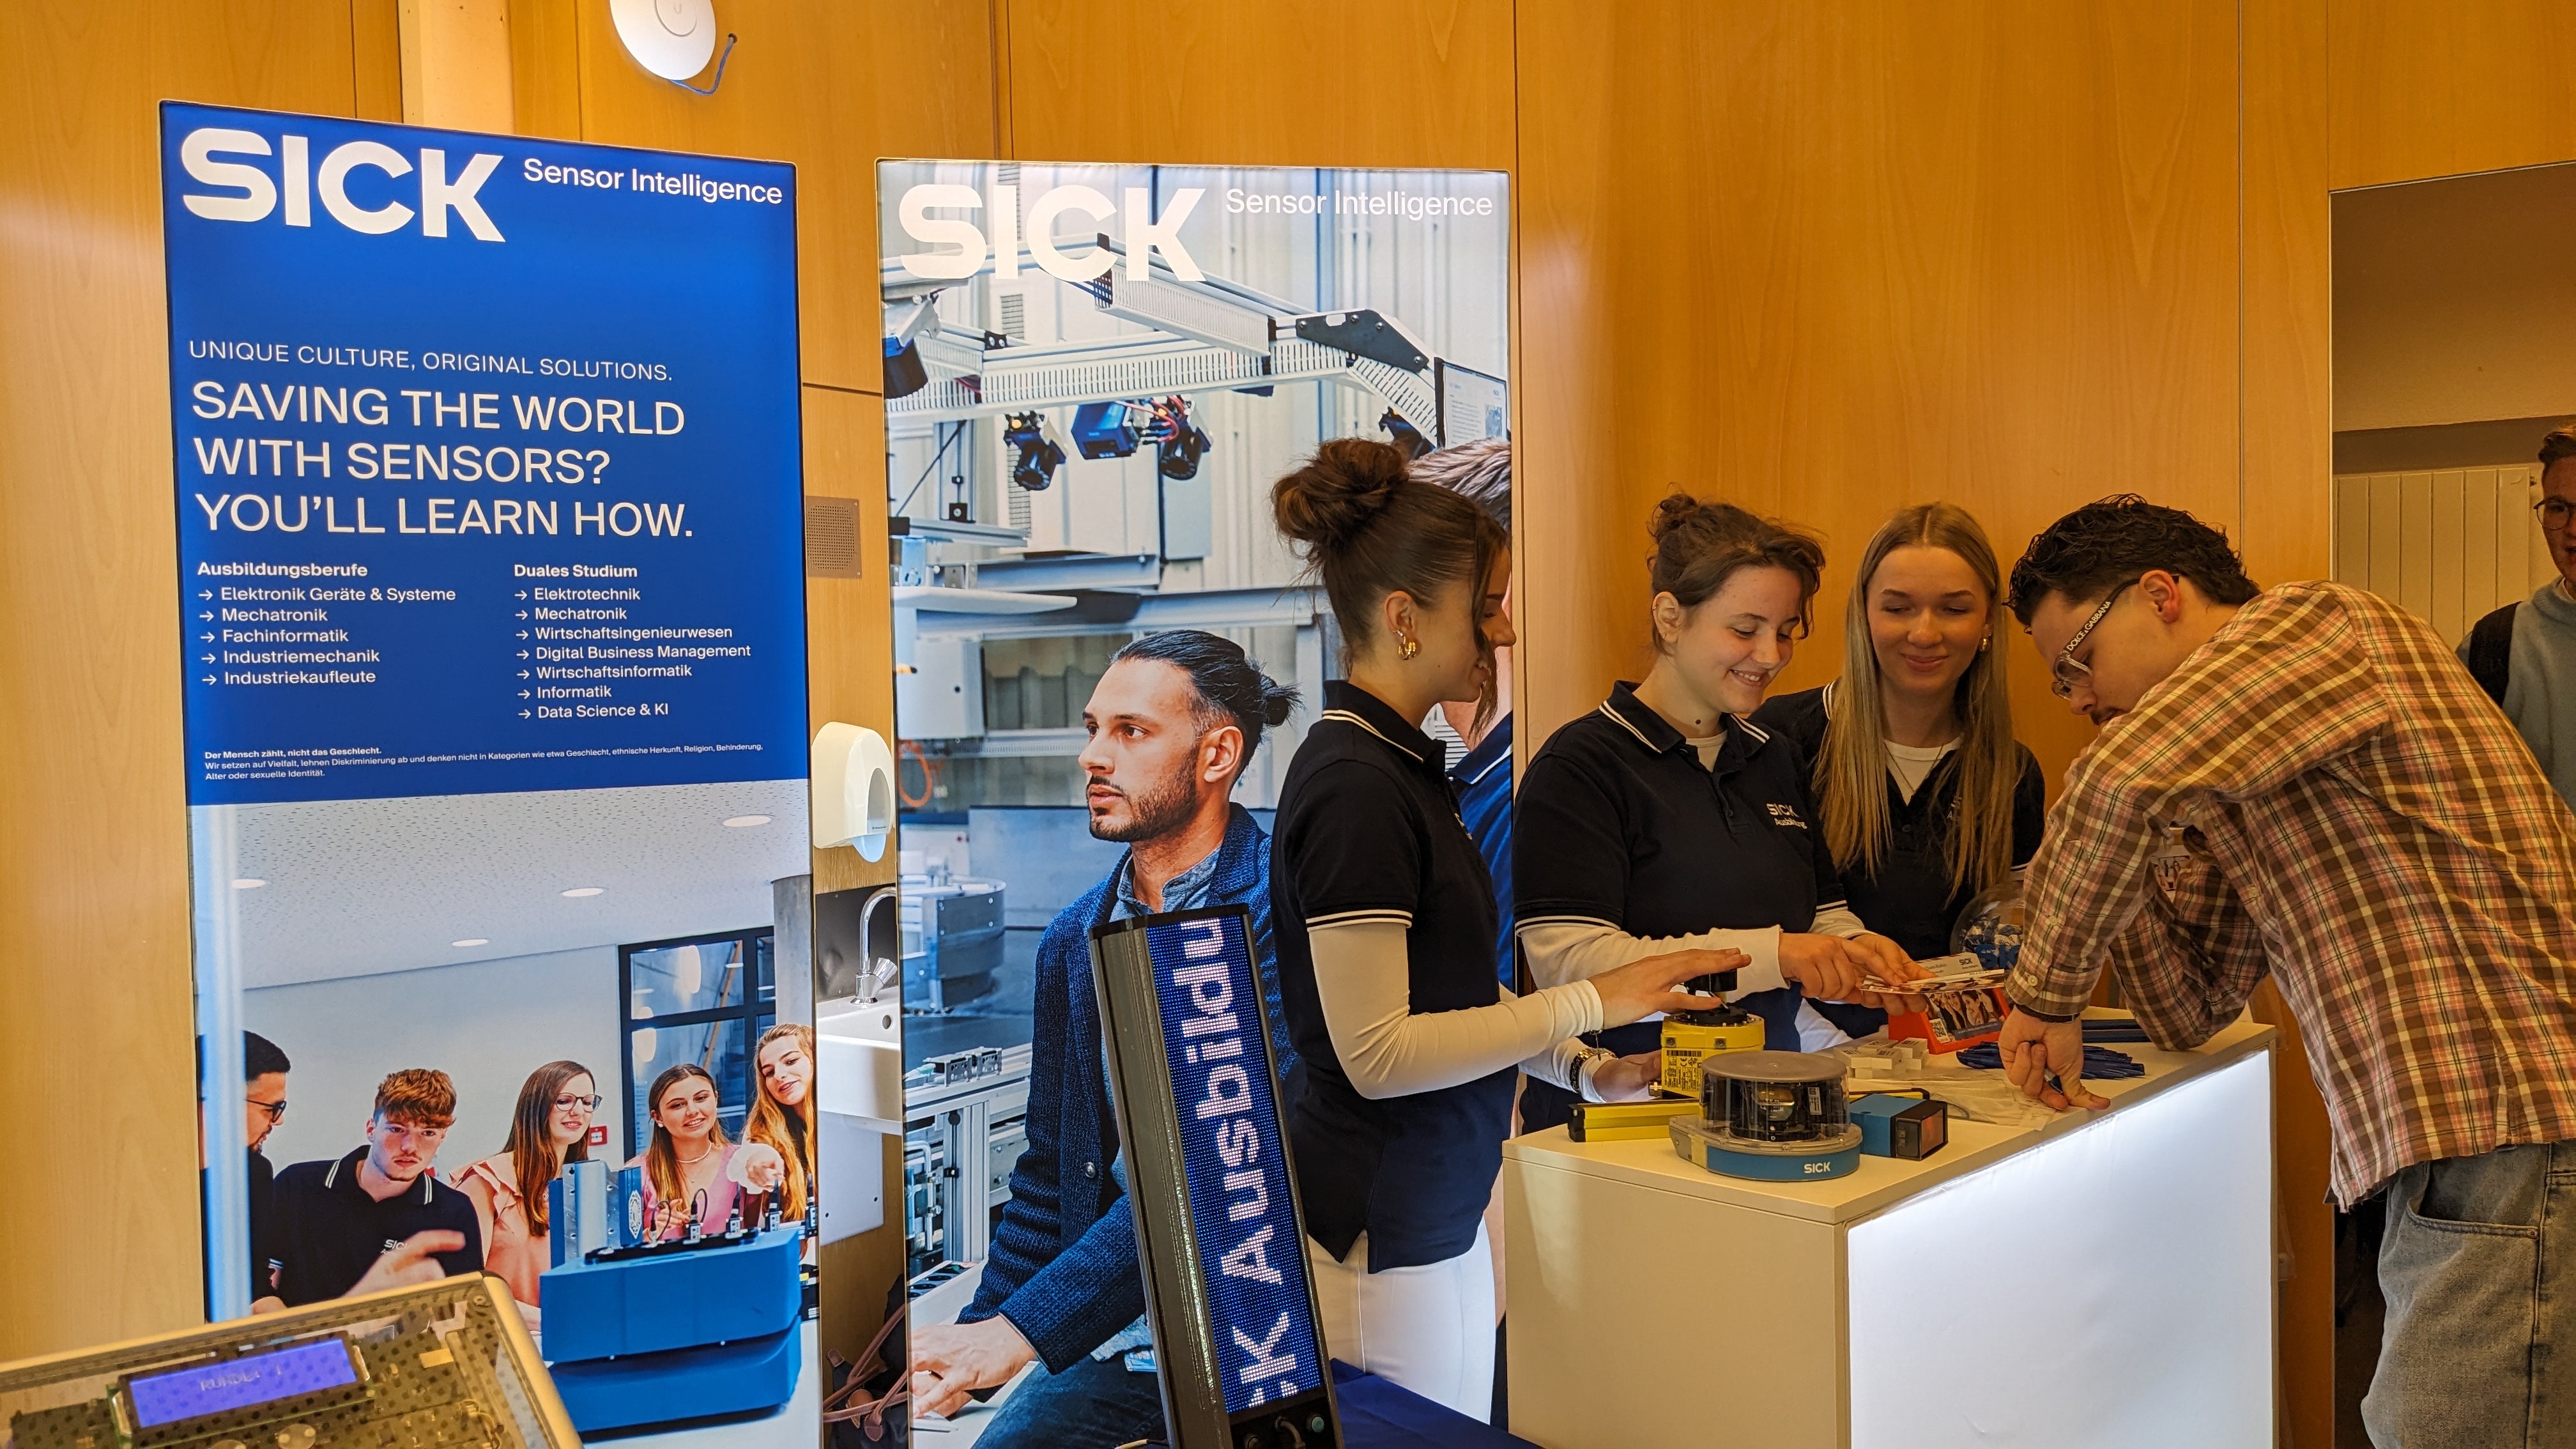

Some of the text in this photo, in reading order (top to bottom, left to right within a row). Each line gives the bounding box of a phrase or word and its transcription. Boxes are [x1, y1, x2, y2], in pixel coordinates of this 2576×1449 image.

[181, 128, 505, 242] SICK
[524, 158, 782, 204] Sensor Intelligence
[1226, 188, 1492, 221] Sensor Intelligence
[899, 184, 1206, 282] SICK
[190, 341, 671, 380] UNIQUE CULTURE, ORIGINAL SOLUTIONS.
[193, 381, 684, 434] SAVING THE WORLD
[194, 438, 610, 484] WITH SENSORS?
[399, 498, 557, 534] LEARN
[575, 502, 692, 536] HOW.
[197, 562, 367, 578] Ausbildungsberufe
[515, 565, 637, 577] Duales Studium
[221, 587, 456, 602] Elektronik Geräte & Systeme
[535, 588, 640, 600] Elektrotechnik
[222, 608, 328, 621] Mechatronik
[535, 608, 627, 620] Mechatronik
[223, 629, 348, 642] Fachinformatik
[535, 627, 732, 641] Wirtschaftsingenieurwesen
[224, 650, 379, 663] Industriemechanik
[537, 646, 751, 661] Digital Business Management
[226, 671, 376, 684] Industriekaufleute
[537, 664, 692, 678] Wirtschaftsinformatik
[538, 686, 611, 698] Informatik
[539, 703, 668, 718] Data Science & KI
[489, 752, 530, 760] Kategorien
[1767, 803, 1799, 818] SICK
[1804, 1162, 1831, 1174] SICK
